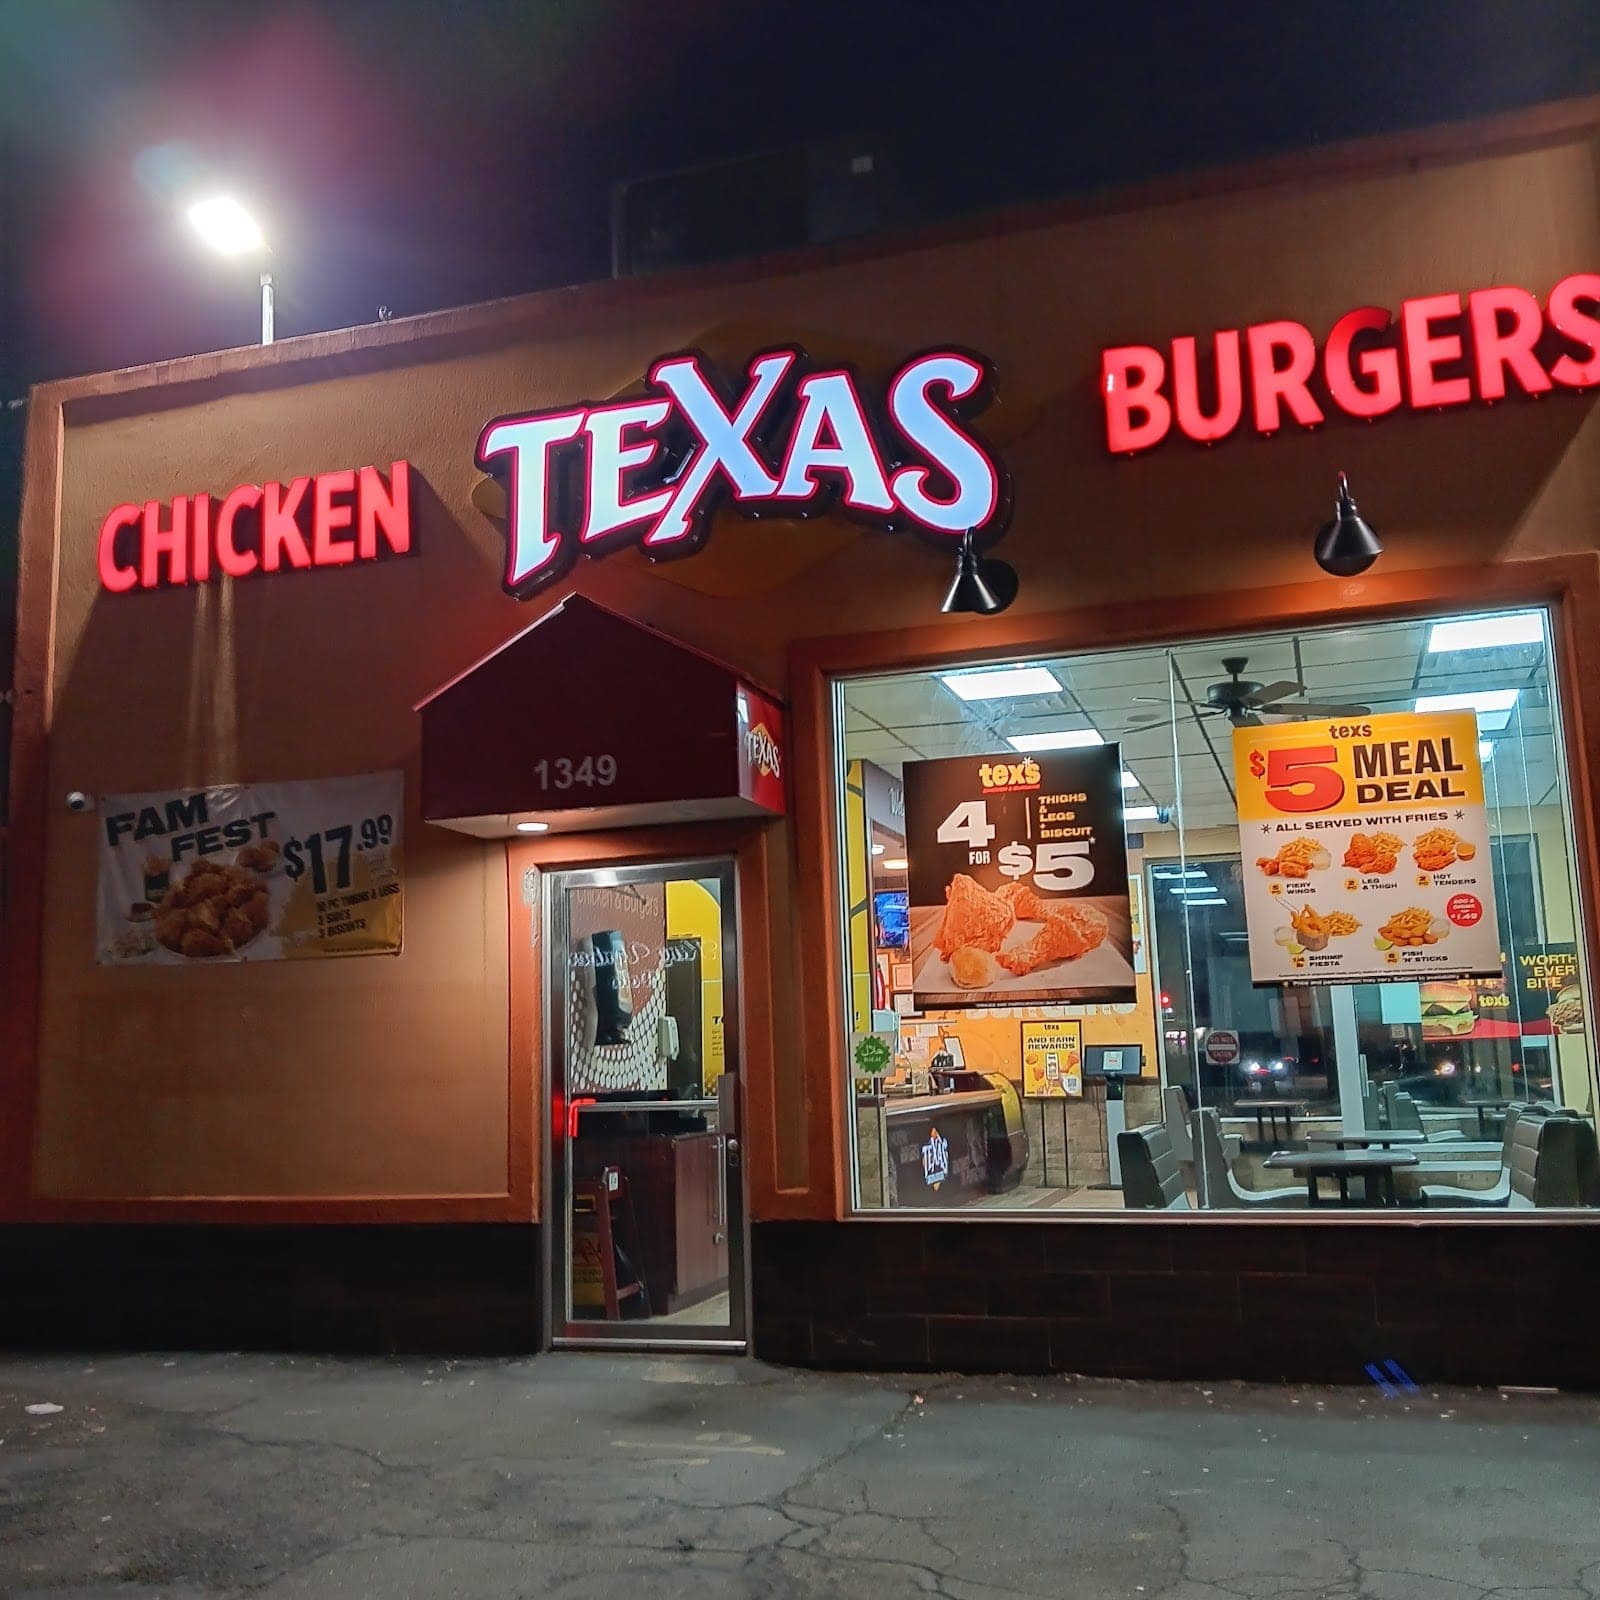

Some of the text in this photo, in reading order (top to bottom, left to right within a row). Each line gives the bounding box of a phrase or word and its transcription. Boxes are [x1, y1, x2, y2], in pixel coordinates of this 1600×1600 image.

[1103, 272, 1600, 454] BURGERS
[480, 349, 998, 585] TEXAS
[98, 460, 411, 592] CHICKEN
[1329, 724, 1373, 740] texs
[534, 754, 617, 791] 1349
[744, 730, 780, 778] TEXAS
[1353, 737, 1464, 779] MEAL
[1038, 792, 1087, 804] THIGHS
[1039, 805, 1048, 813] &
[1357, 778, 1465, 804] DEAL
[106, 792, 209, 846] FAM
[171, 811, 276, 862] FEST
[937, 800, 995, 848] 4
[1040, 812, 1075, 822] LEGS
[1040, 827, 1093, 838] BISCUIT
[1275, 812, 1448, 832] ALL SERVED WITH FRIES
[283, 813, 393, 895] $17.99
[969, 851, 990, 865] FOR
[1526, 976, 1562, 989] BITE
[921, 1134, 948, 1178] TEXAS
